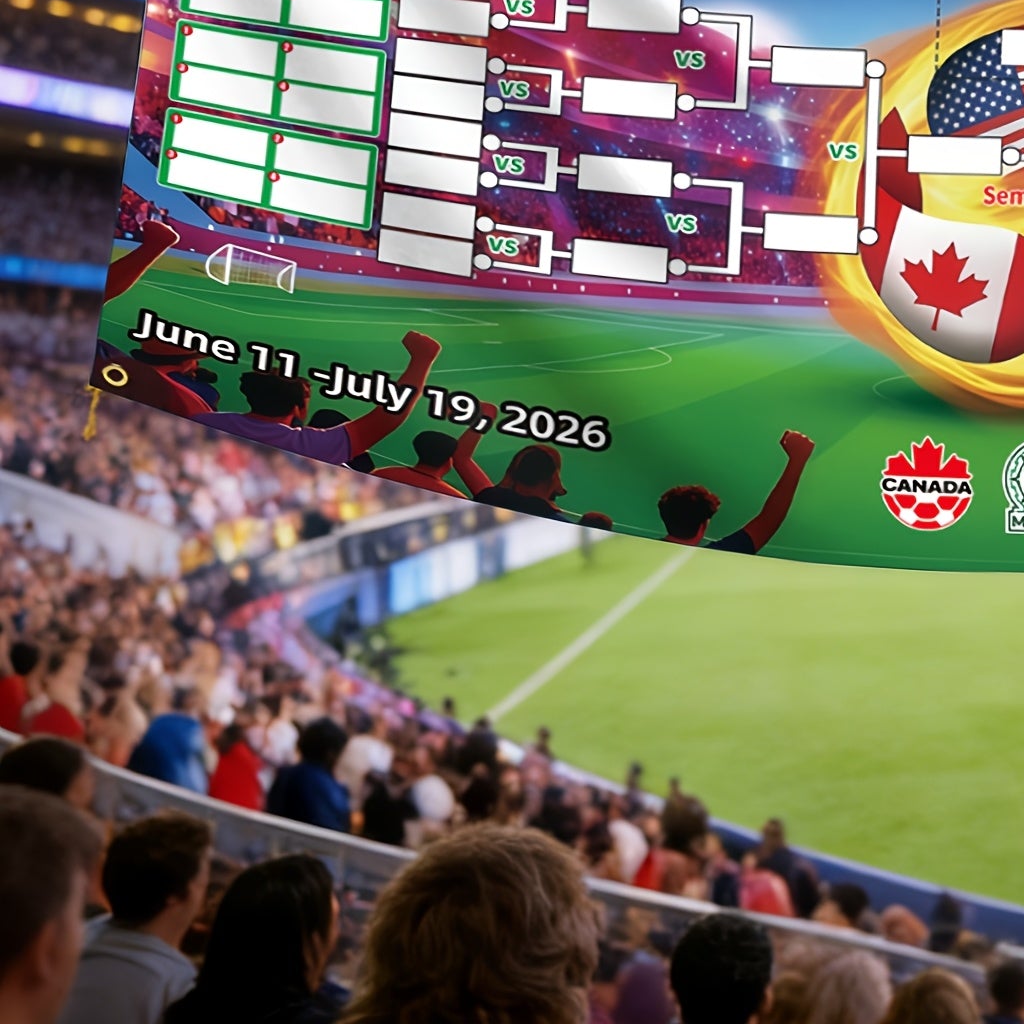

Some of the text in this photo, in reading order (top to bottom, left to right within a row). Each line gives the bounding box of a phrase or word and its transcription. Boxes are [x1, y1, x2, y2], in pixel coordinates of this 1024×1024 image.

[132, 312, 236, 362] June
[251, 344, 295, 378] 11
[428, 388, 489, 431] 19,
[501, 405, 607, 449] 2026
[881, 476, 972, 496] CANADA
